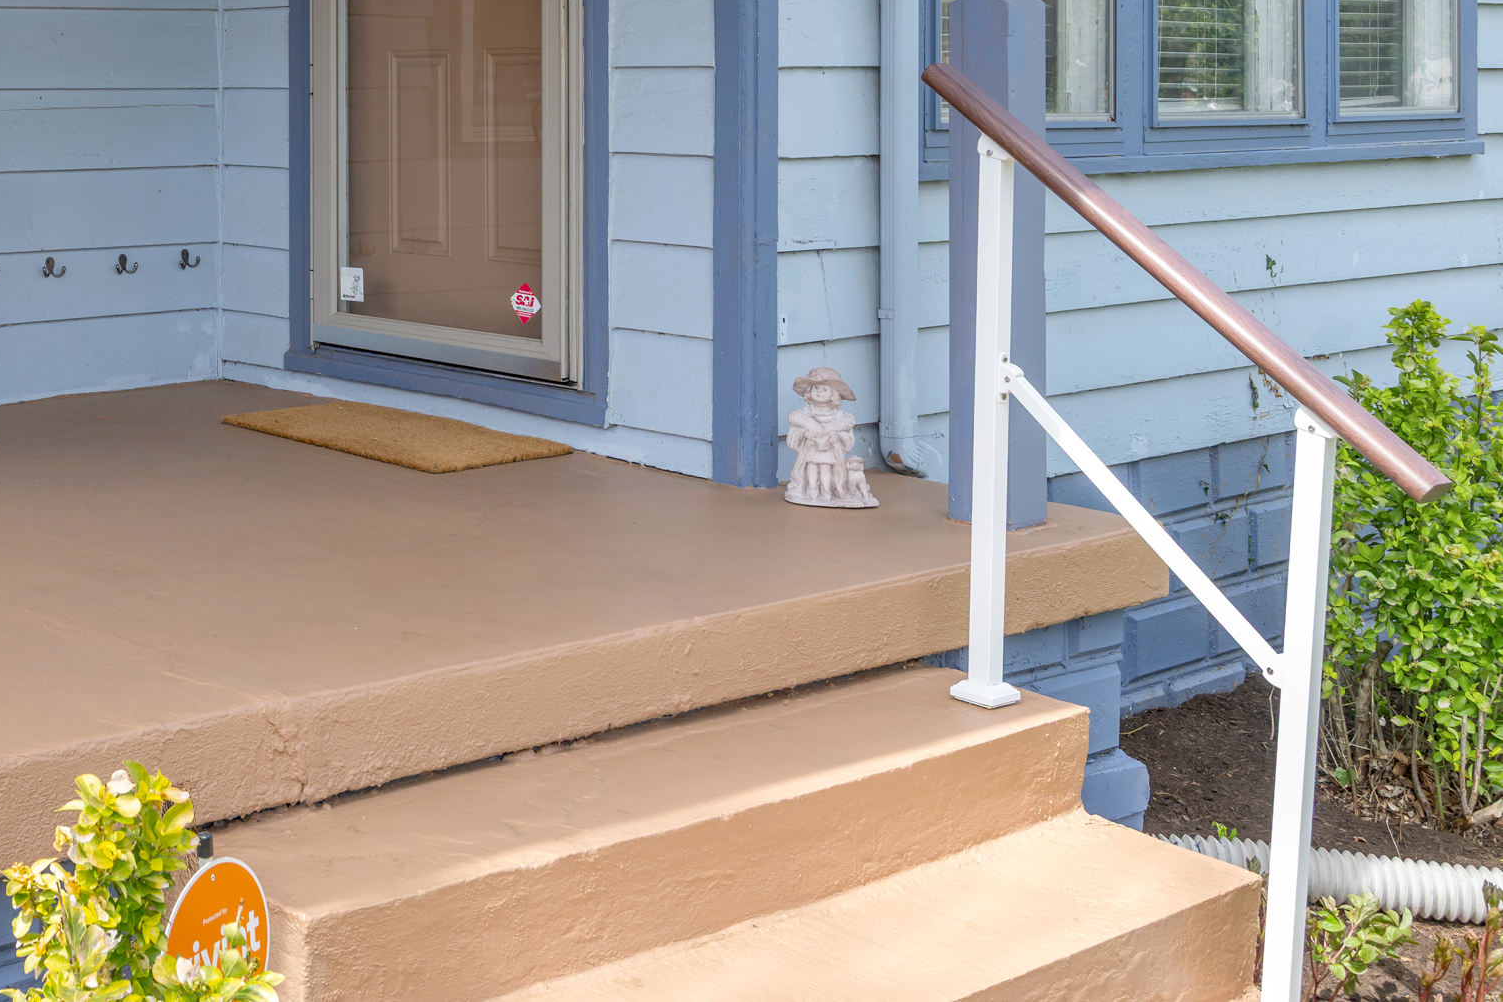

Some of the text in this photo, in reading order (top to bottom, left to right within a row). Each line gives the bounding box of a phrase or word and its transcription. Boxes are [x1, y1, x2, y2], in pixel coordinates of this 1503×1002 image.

[203, 907, 228, 926] Protected by
[187, 909, 261, 971] ivit
